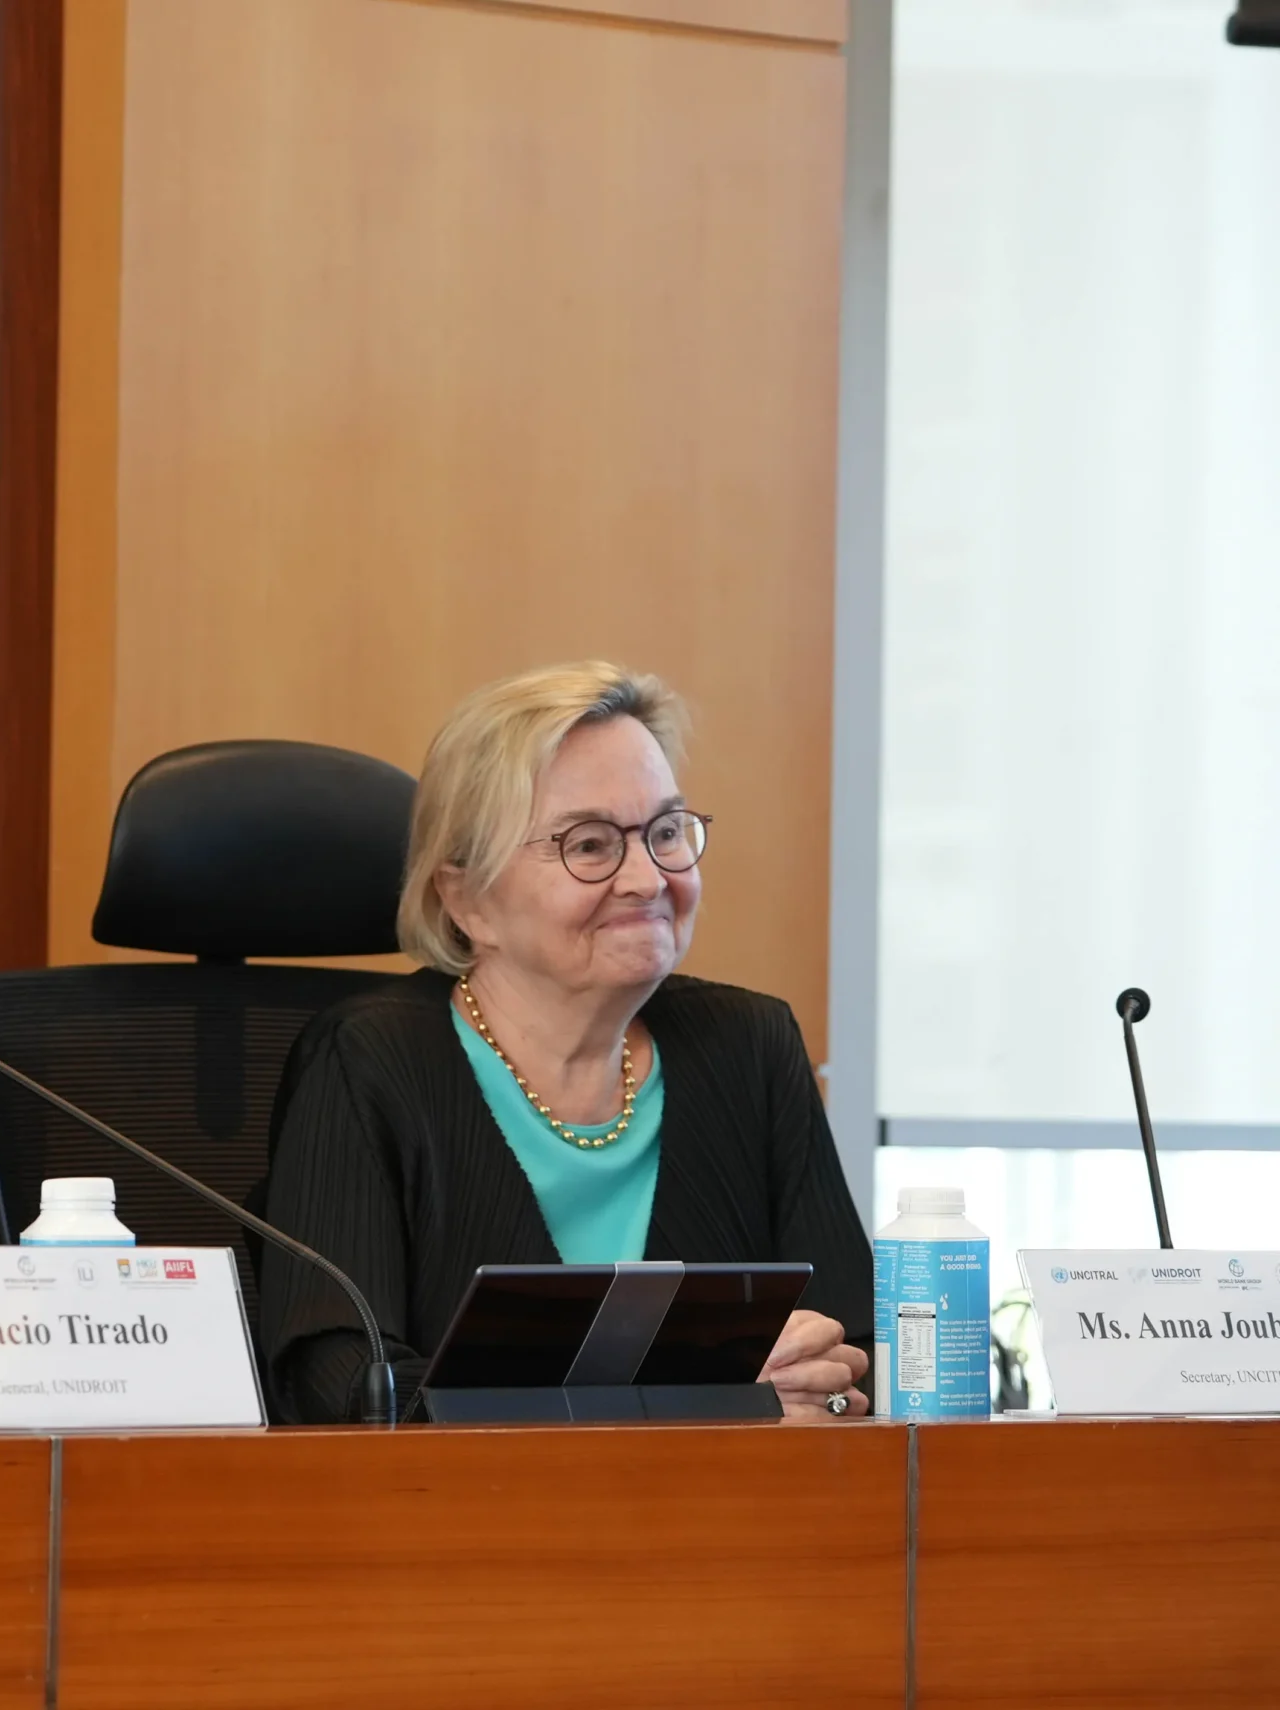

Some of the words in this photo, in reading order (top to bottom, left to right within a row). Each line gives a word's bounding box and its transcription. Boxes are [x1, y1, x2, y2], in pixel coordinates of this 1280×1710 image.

[940, 1254, 954, 1262] YOU
[946, 1263, 965, 1271] GOOD
[1152, 1268, 1202, 1278] UNIDROIT
[1070, 1270, 1119, 1281] UNCITRAL
[59, 1314, 169, 1346] Tirado
[1076, 1311, 1131, 1340] Ms.
[1138, 1312, 1213, 1339] Anna
[1180, 1370, 1236, 1386] Secretary,
[1236, 1370, 1280, 1383] UNCIT
[52, 1378, 128, 1395] UNIDROIT
